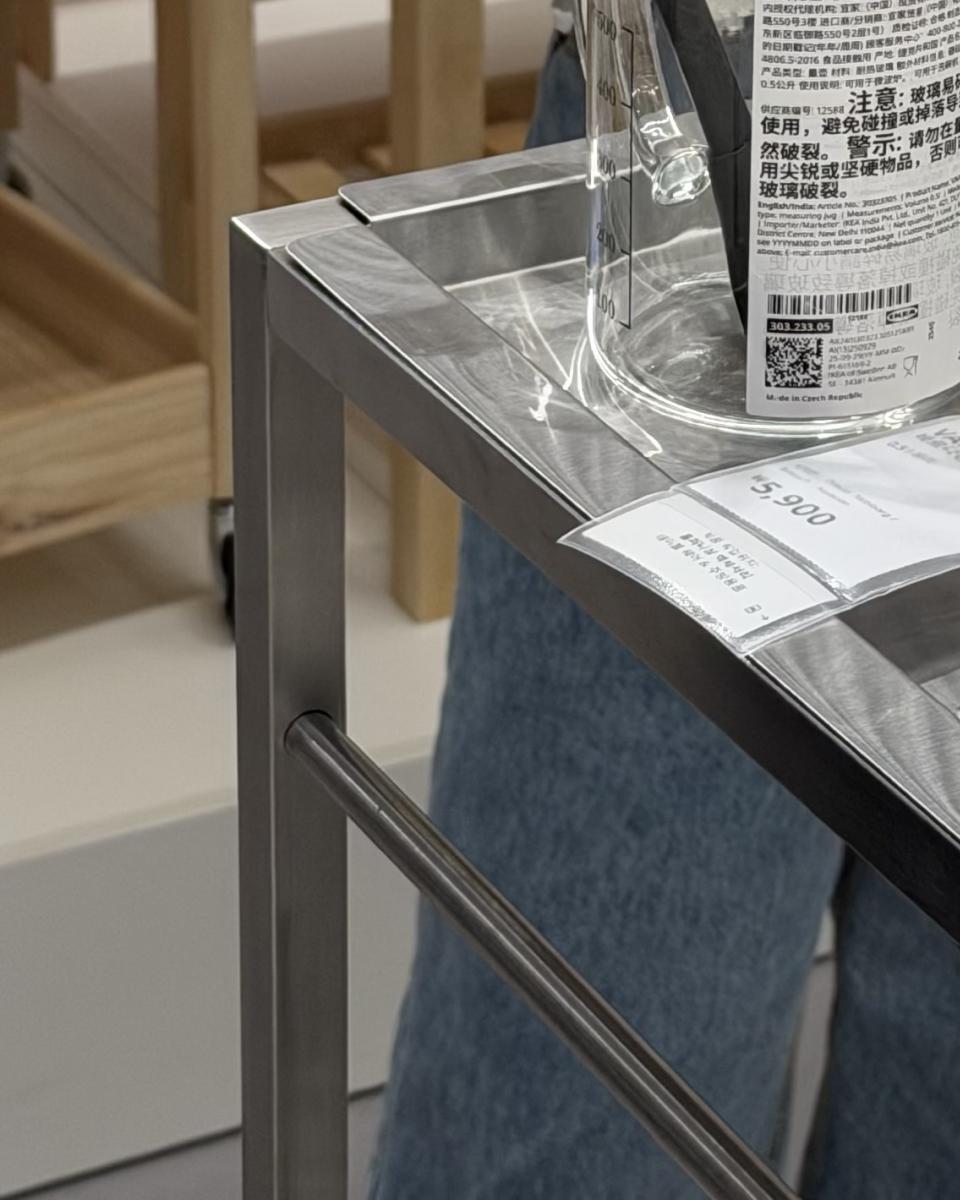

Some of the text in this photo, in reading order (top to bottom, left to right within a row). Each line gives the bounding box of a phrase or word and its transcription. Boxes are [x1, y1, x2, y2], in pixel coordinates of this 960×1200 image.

[760, 141, 829, 161] 然破裂。
[759, 180, 848, 200] 玻璃破裂。
[817, 200, 843, 210] Article
[779, 211, 822, 221] measuring
[823, 210, 837, 221] jug
[838, 228, 859, 237] Delhi
[887, 307, 917, 320] IKEA
[769, 321, 832, 332] 303.233.05
[791, 394, 800, 402] in
[802, 394, 826, 402] Czech
[828, 391, 863, 402] Republic
